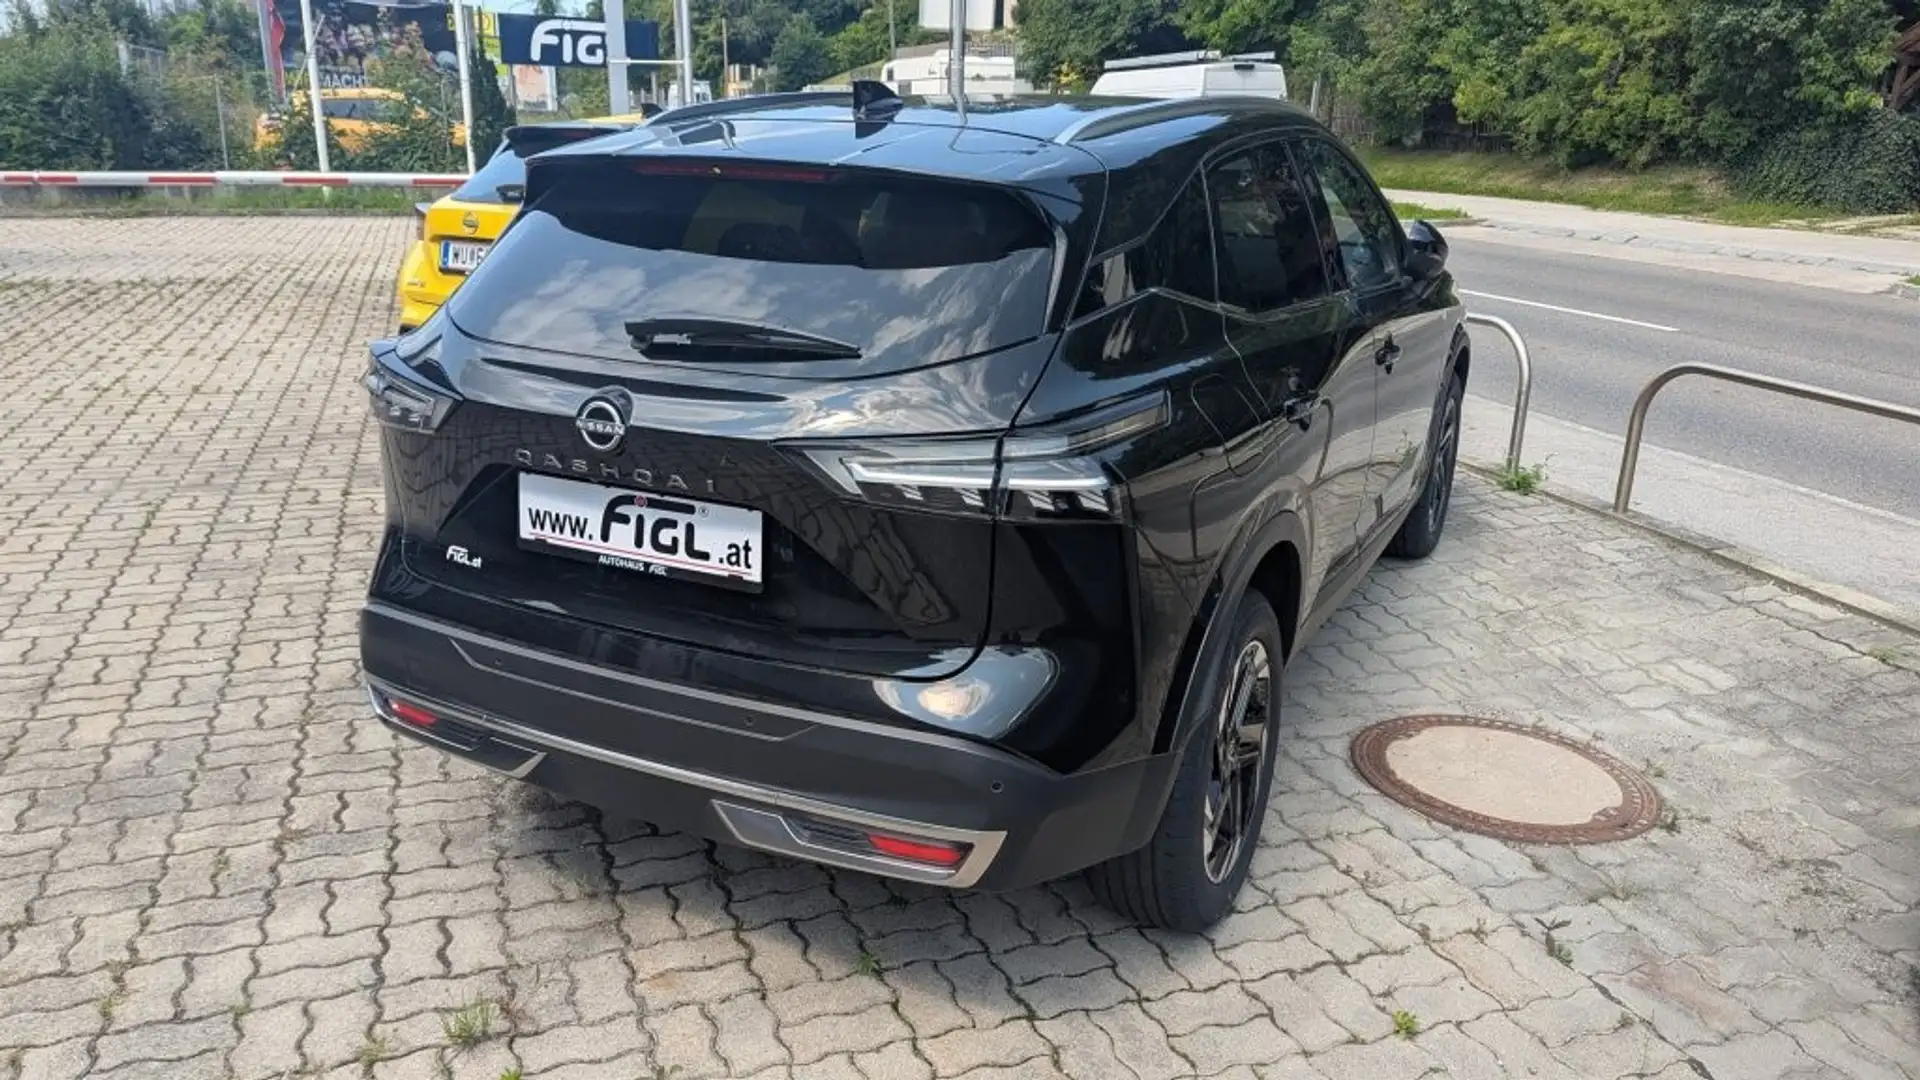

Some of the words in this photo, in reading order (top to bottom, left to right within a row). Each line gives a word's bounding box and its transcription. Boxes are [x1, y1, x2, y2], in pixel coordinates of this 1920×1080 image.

[530, 18, 607, 65] FIG
[575, 417, 625, 437] NISSAN
[514, 448, 717, 495] QASHQAI
[598, 554, 645, 572] AUTOHAUS
